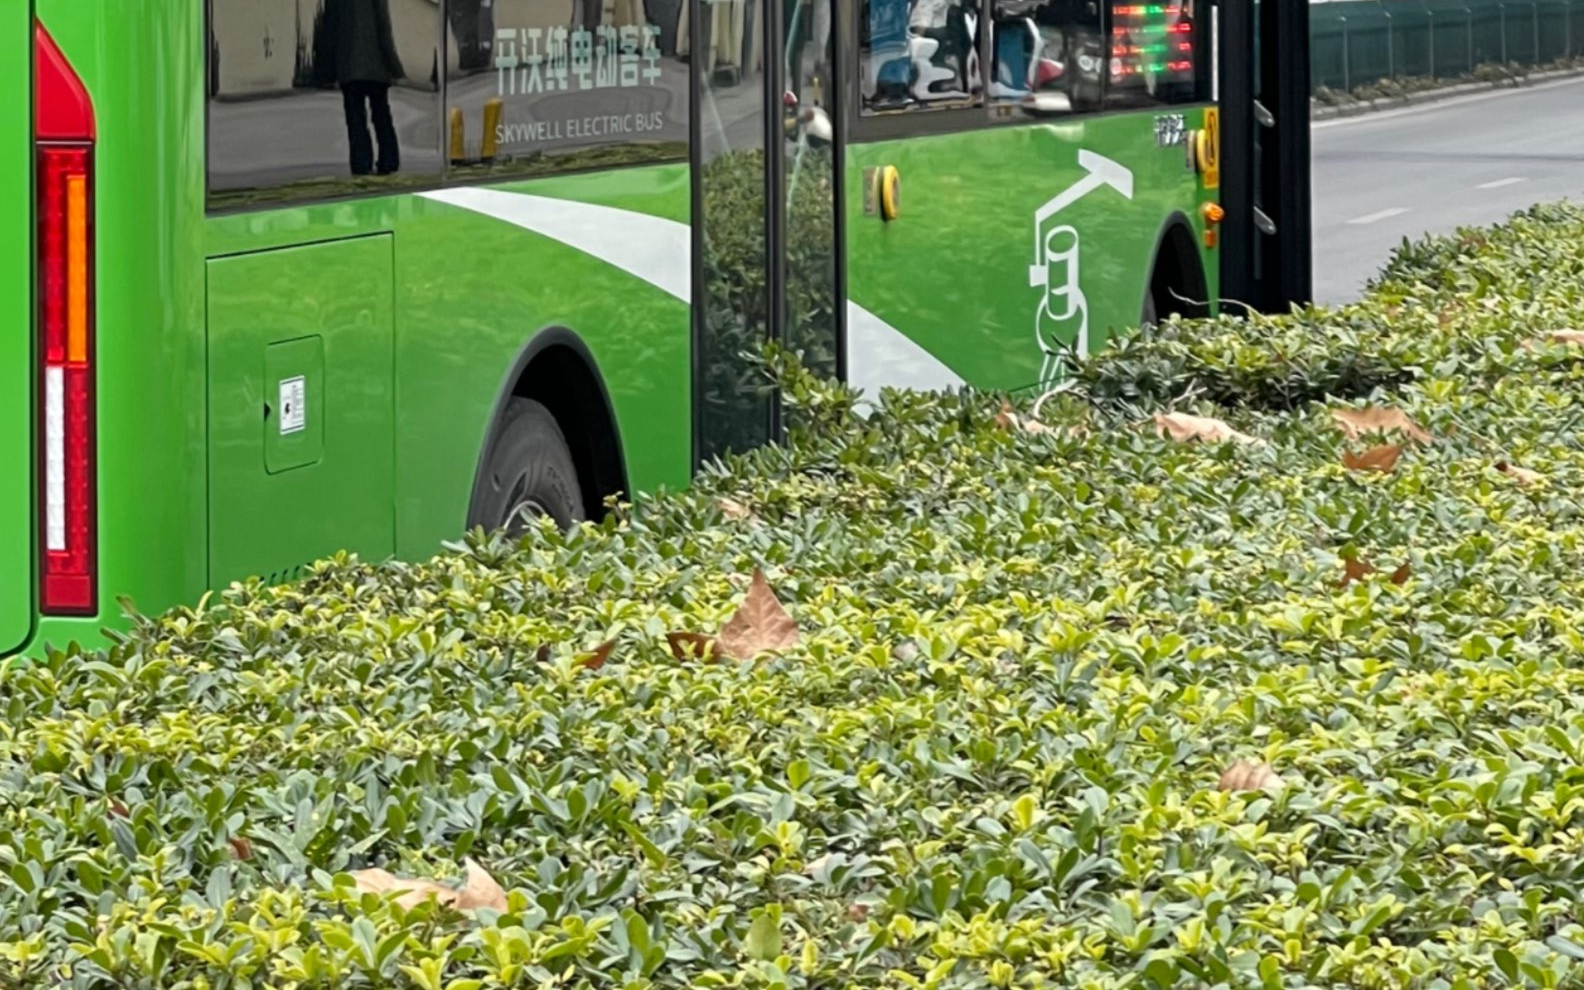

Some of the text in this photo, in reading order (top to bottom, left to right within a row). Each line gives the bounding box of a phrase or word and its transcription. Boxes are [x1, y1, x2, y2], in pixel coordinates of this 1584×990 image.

[495, 25, 663, 96] 开沃纯电动客车
[494, 111, 664, 145] SKYWELL ELECTRIC BUS
